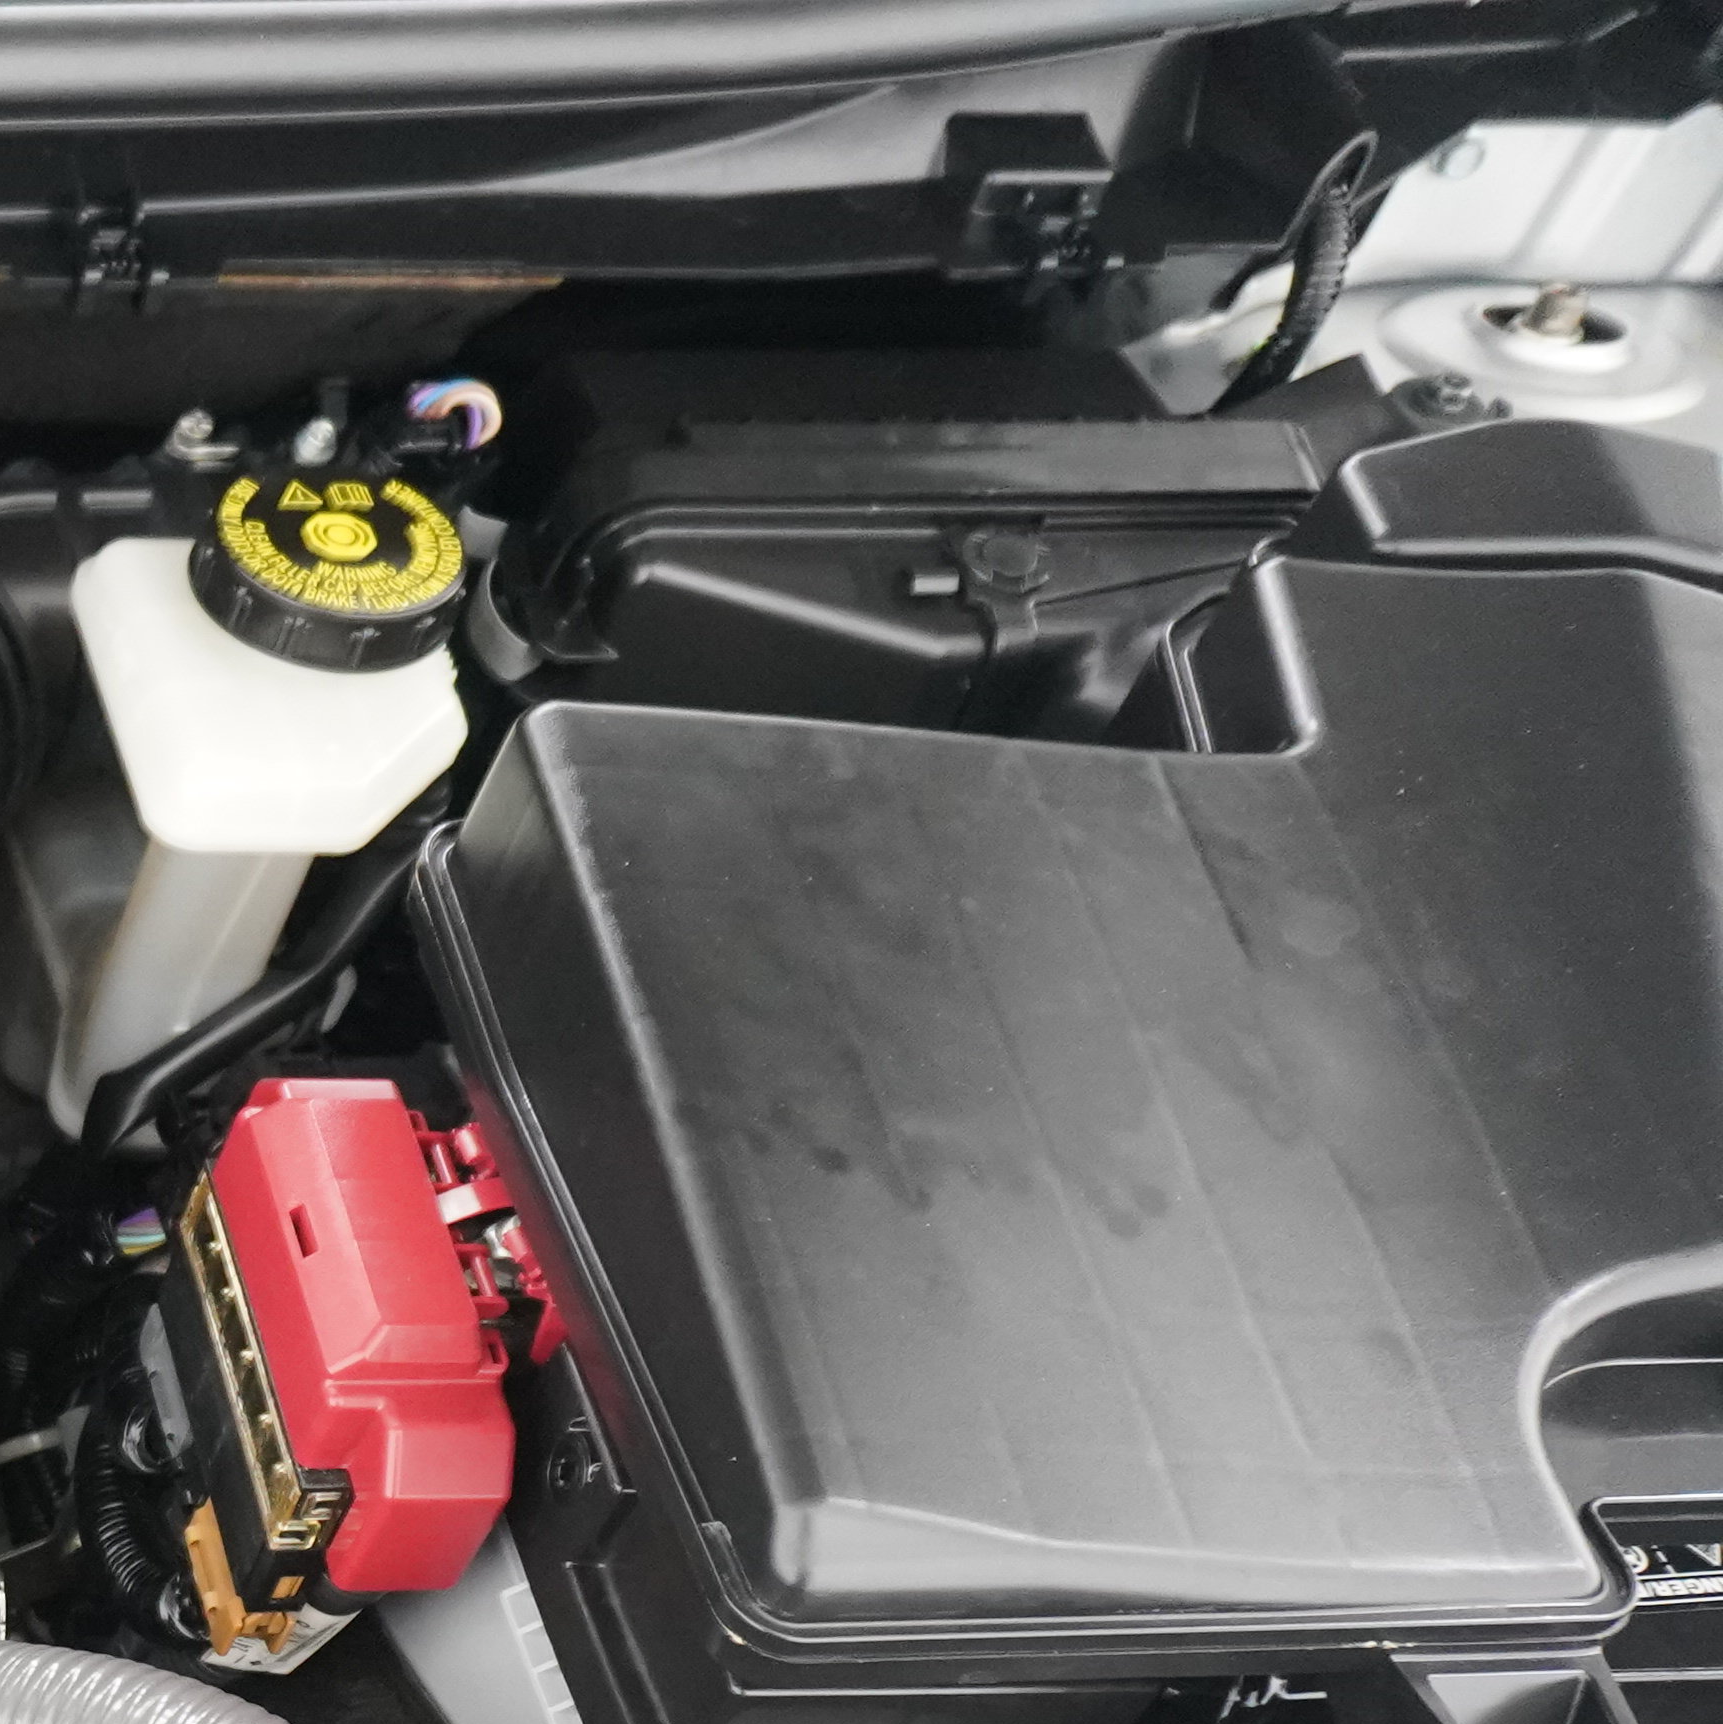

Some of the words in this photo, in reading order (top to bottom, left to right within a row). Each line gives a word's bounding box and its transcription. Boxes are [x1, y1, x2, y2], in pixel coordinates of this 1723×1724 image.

[242, 554, 269, 574] OR
[305, 588, 358, 610] BRAKE
[364, 590, 409, 611] FLUID
[245, 520, 279, 557] CLEAN
[268, 554, 322, 589] FILLER
[324, 580, 358, 598] CAP
[360, 571, 422, 597] BEFORE
[317, 560, 397, 582] WARNING
